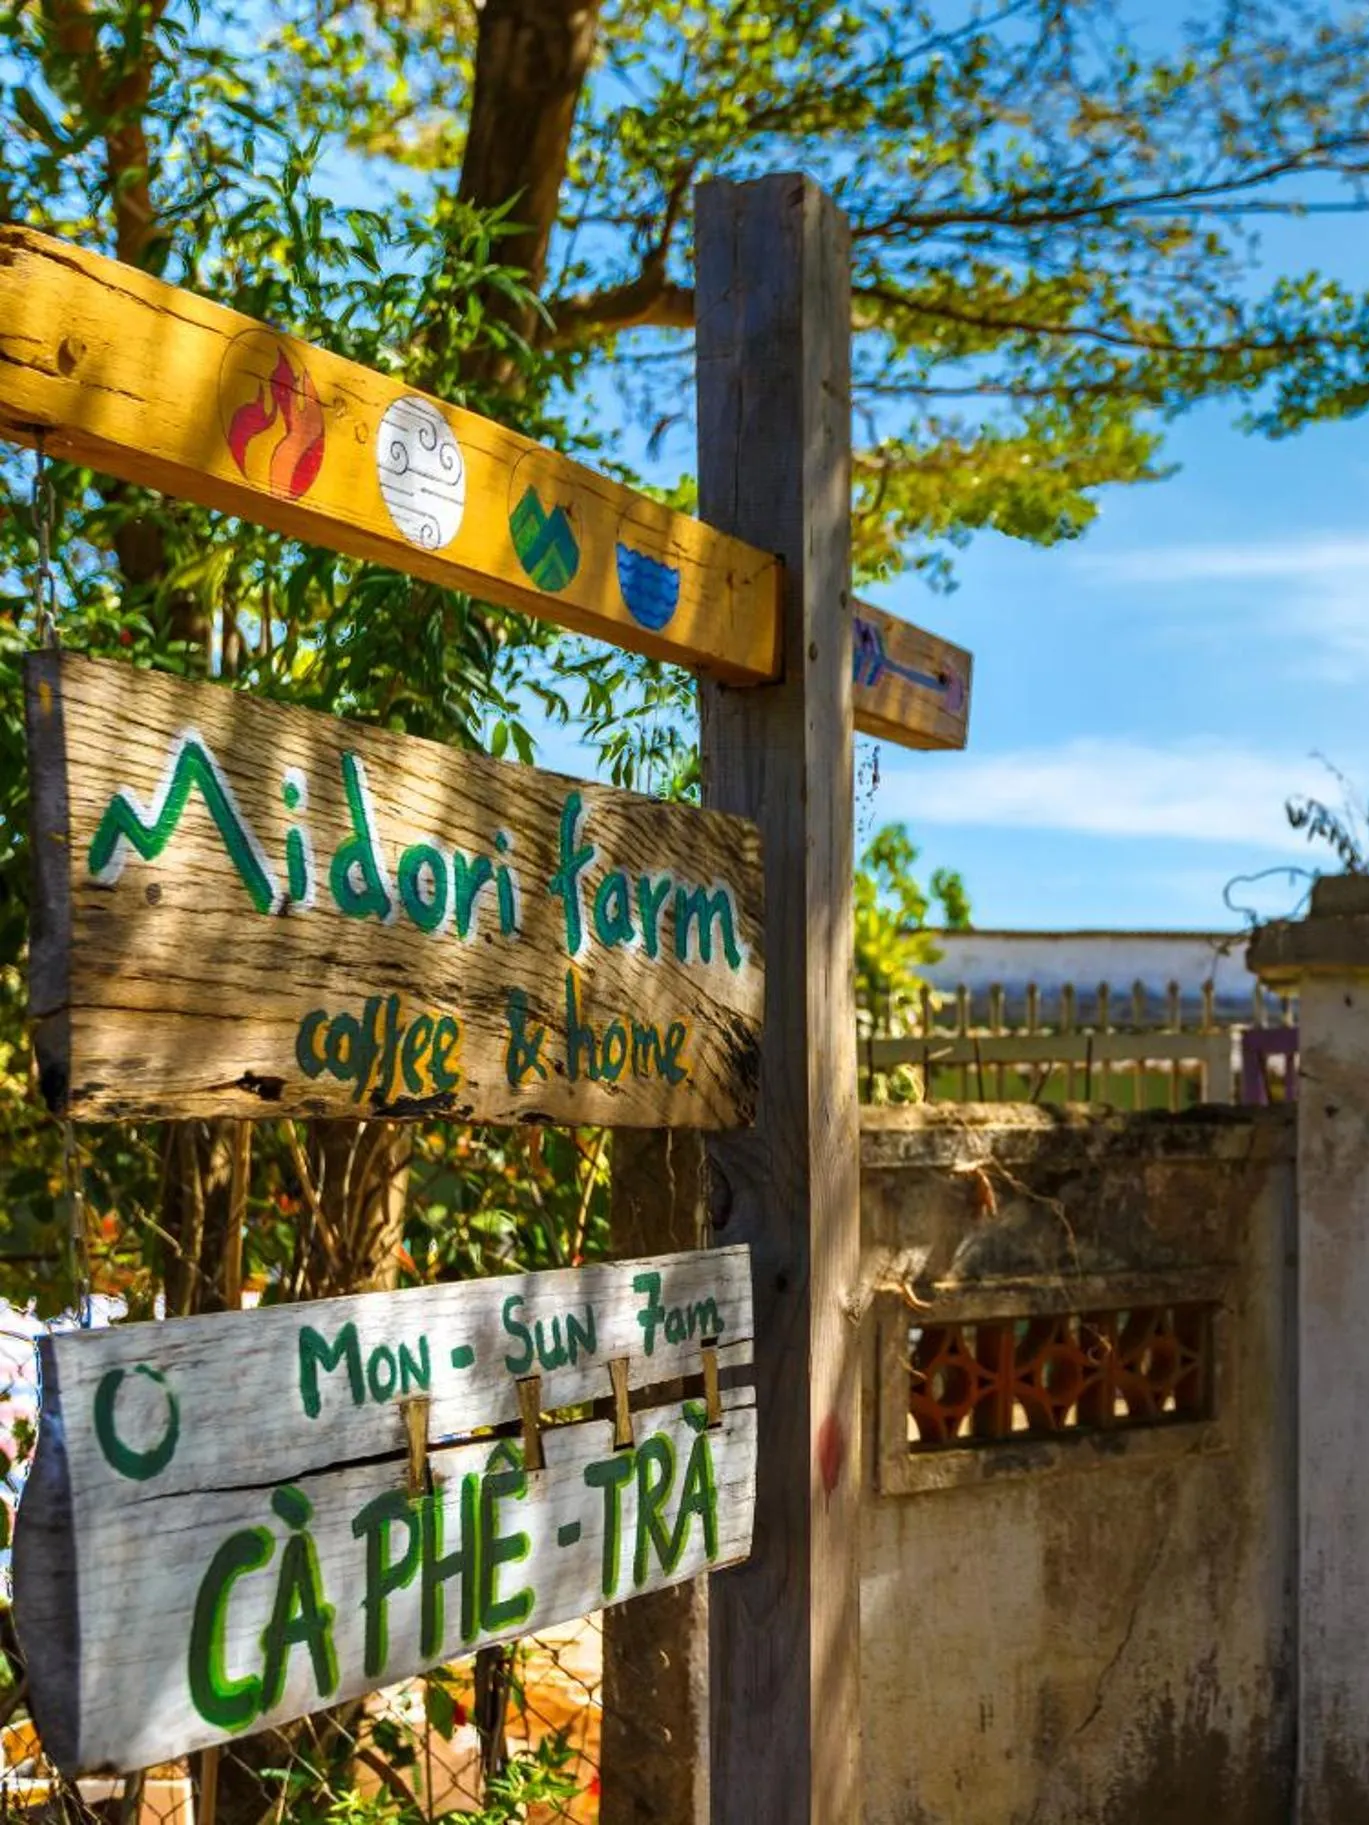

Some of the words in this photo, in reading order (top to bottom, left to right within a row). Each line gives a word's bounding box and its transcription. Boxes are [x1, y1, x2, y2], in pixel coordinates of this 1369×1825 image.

[88, 728, 520, 943] Midori
[550, 792, 748, 972] farm
[296, 993, 464, 1104] coffee
[566, 966, 693, 1087] home
